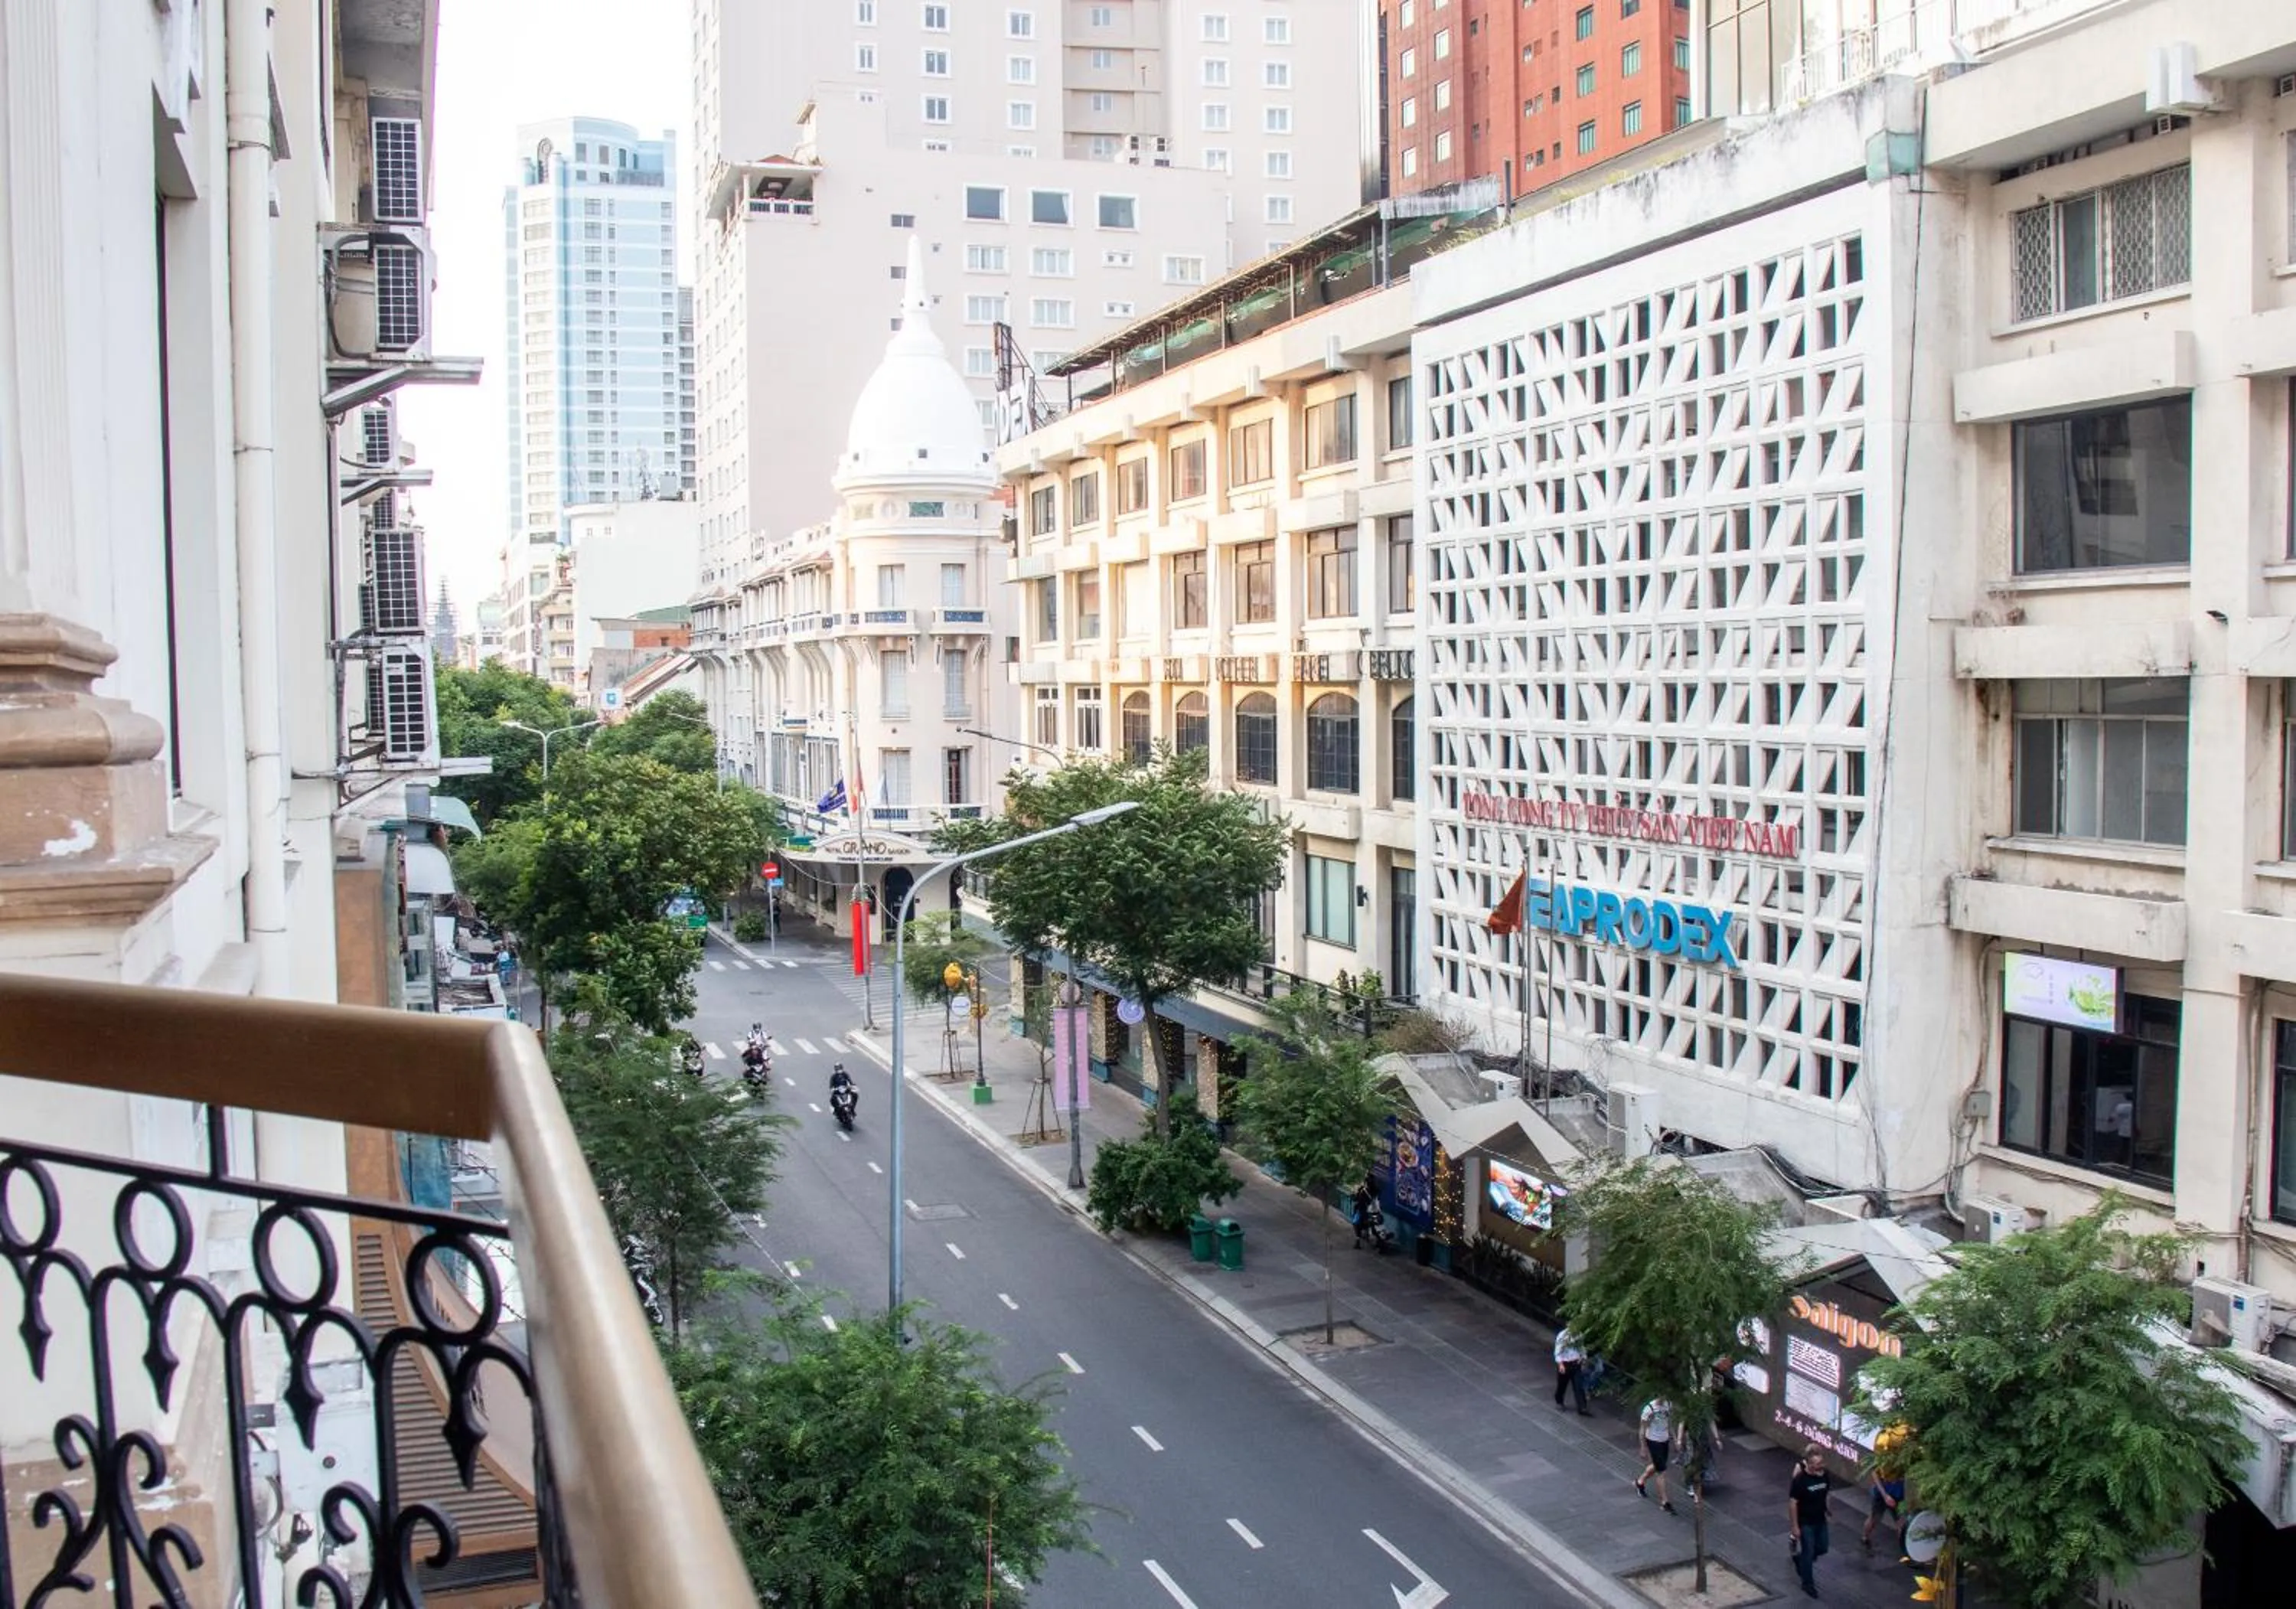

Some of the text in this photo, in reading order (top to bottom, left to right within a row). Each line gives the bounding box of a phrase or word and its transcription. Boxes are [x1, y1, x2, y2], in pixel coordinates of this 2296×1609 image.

[843, 841, 886, 855] GRAND
[1743, 821, 1799, 858] NAM
[1788, 1294, 1902, 1358] Saigon
